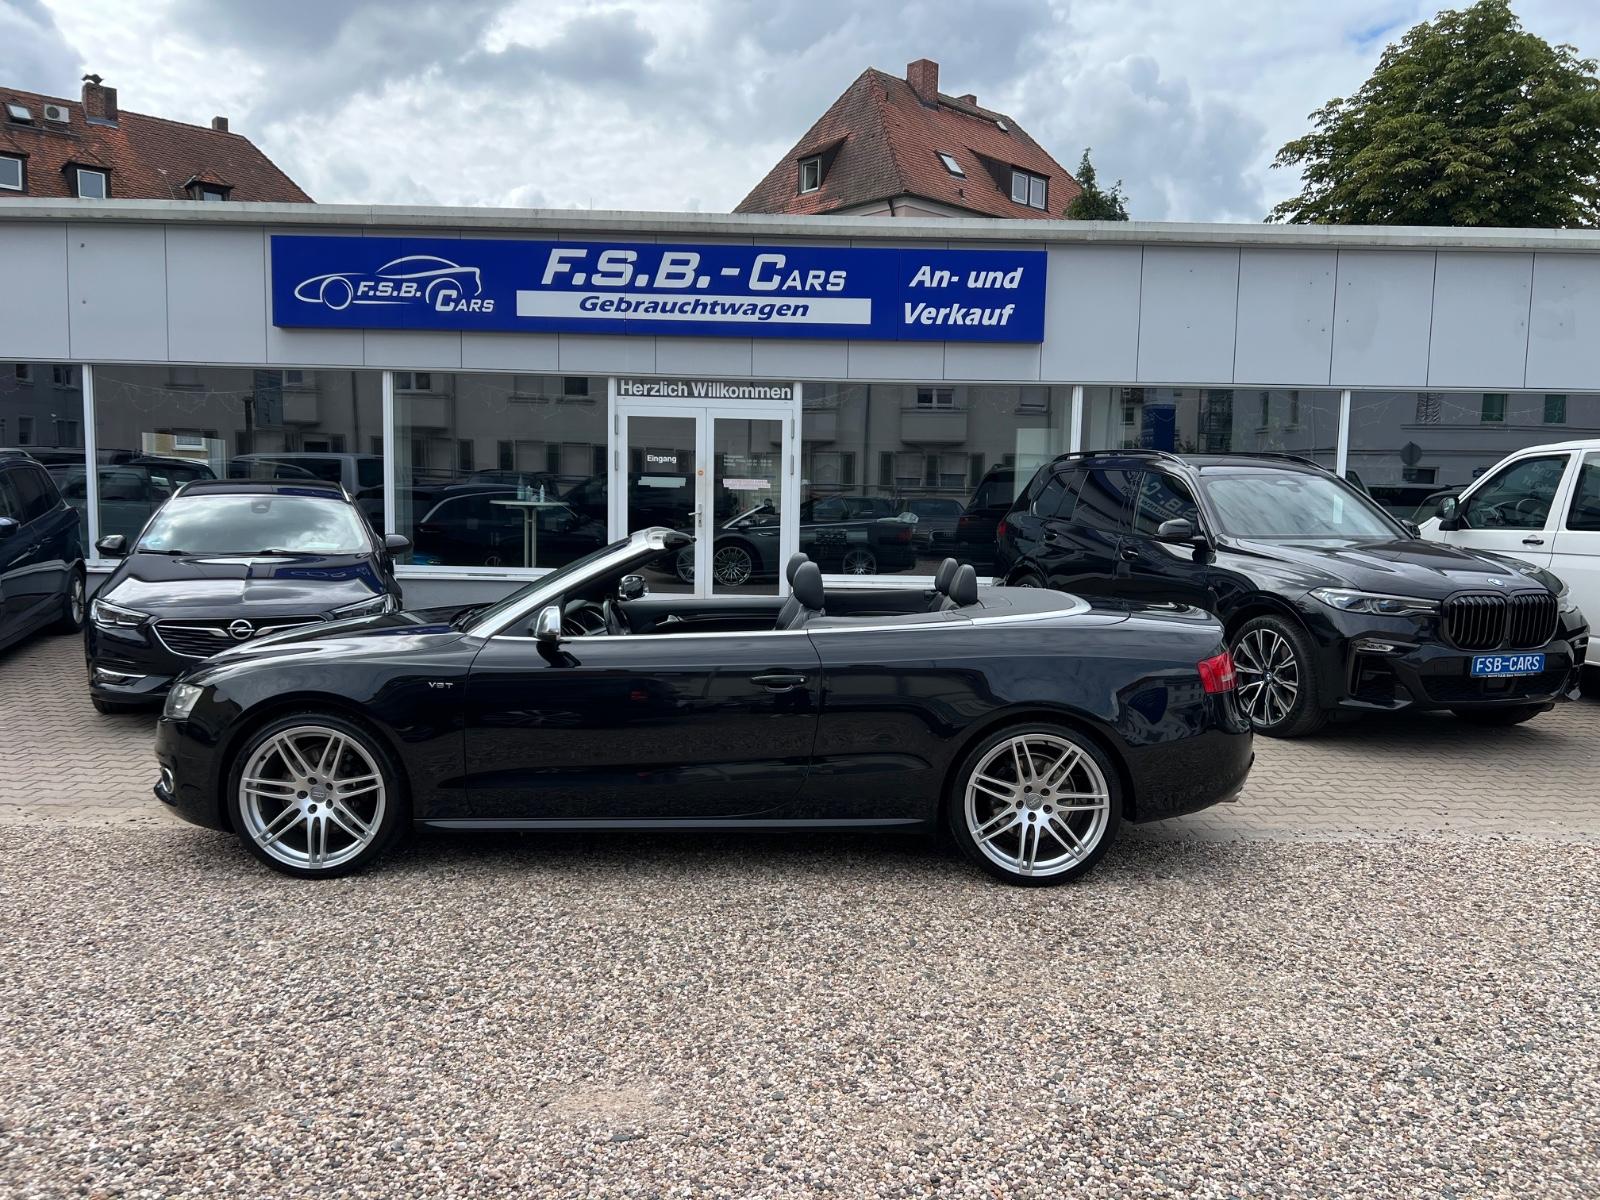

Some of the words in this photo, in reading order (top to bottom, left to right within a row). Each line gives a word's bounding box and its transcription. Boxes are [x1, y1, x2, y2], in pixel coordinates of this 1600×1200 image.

[908, 265, 960, 288] An-
[967, 267, 1024, 289] und
[356, 281, 422, 297] F.S.B.
[579, 296, 810, 321] Gebrauchtwagen
[904, 302, 1016, 326] Verkauf
[620, 379, 688, 397] Herzlich
[691, 381, 791, 399] Willkommen
[647, 454, 677, 464] Eingang
[1476, 656, 1540, 672] FSB-CARS
